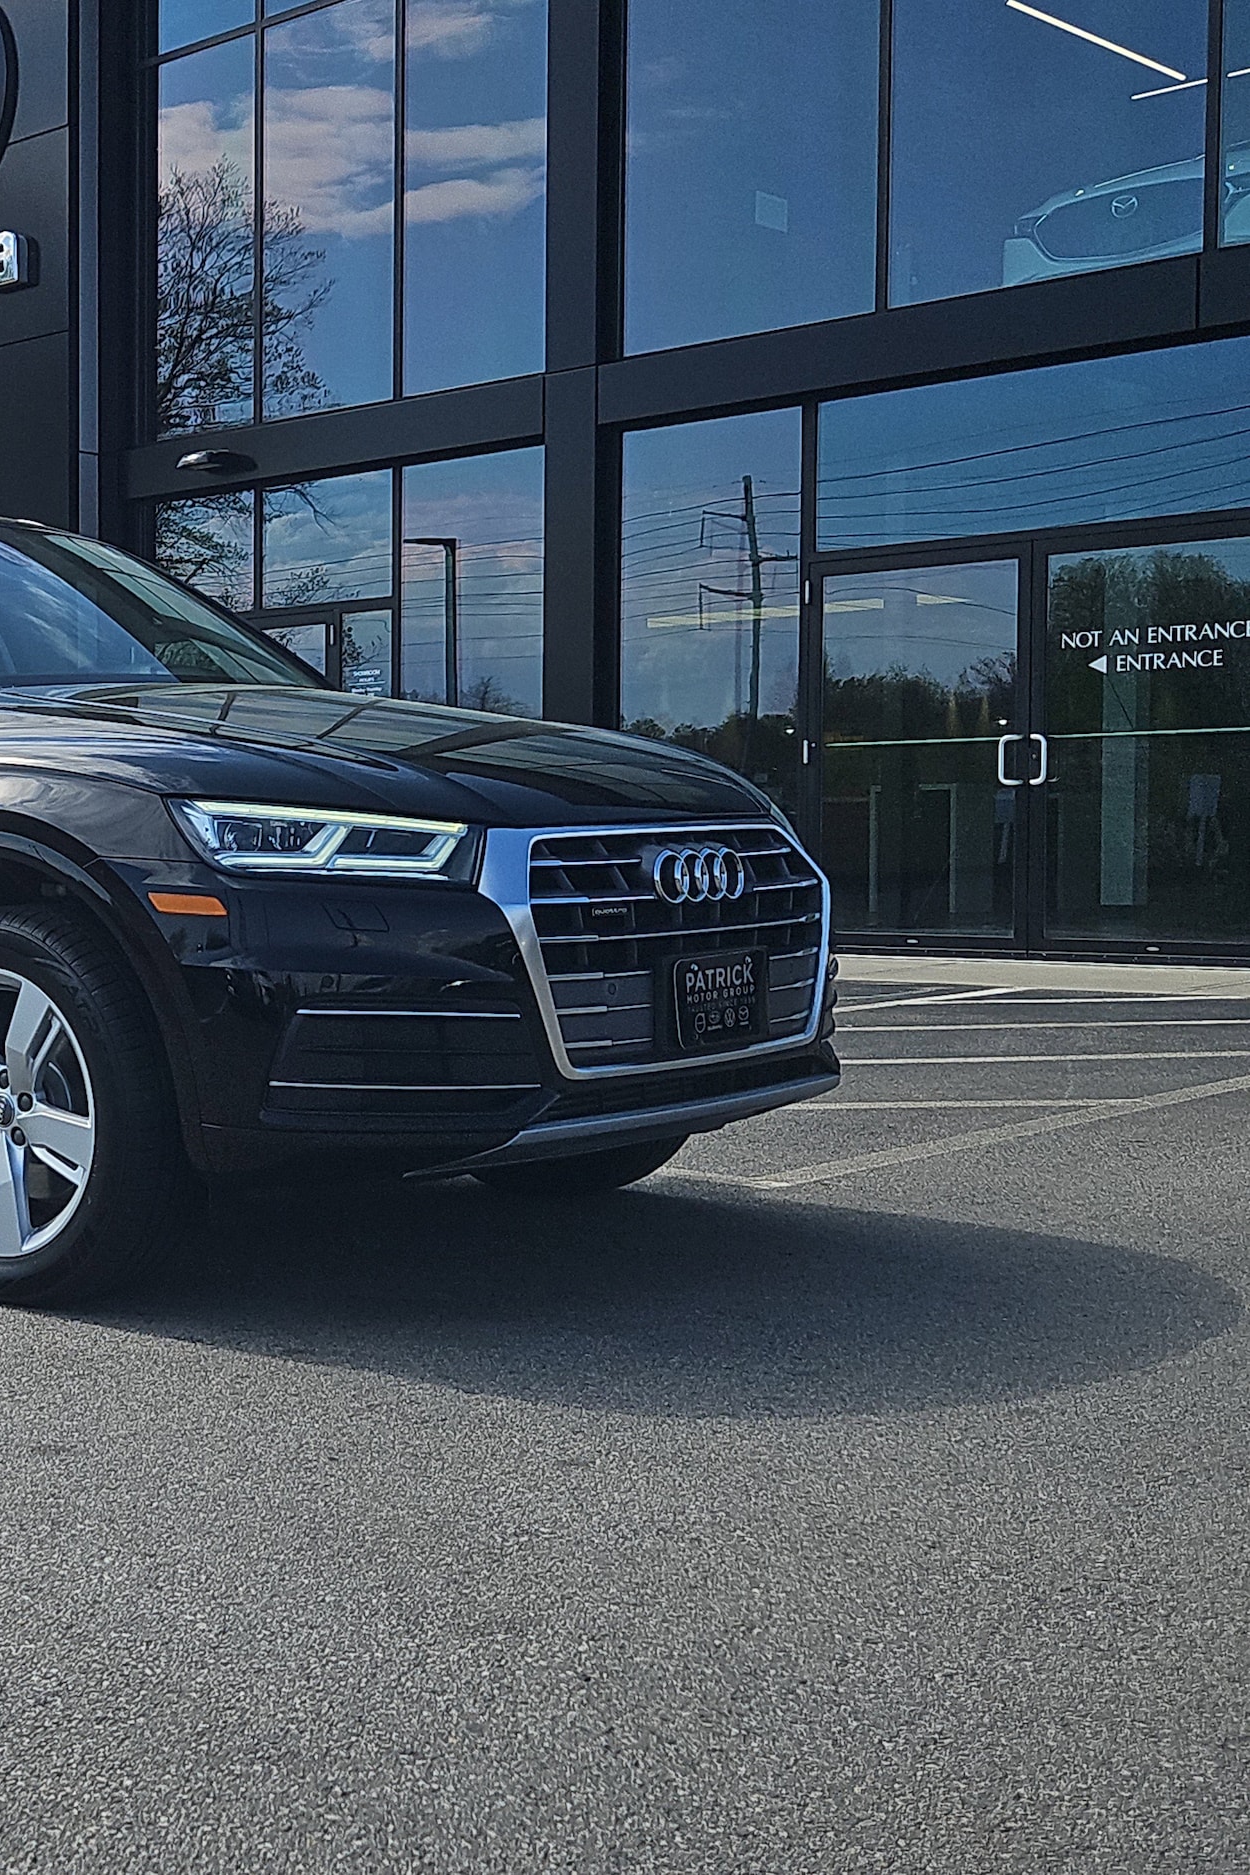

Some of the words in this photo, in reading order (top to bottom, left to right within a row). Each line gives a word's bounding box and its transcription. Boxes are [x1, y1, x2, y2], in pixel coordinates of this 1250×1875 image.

[1061, 630, 1102, 649] NOT
[1109, 628, 1140, 646] AN
[1116, 649, 1223, 672] ENTRANCE
[686, 963, 754, 993] PATRICK
[687, 991, 718, 1004] MOTOR
[723, 984, 755, 998] GROUP
